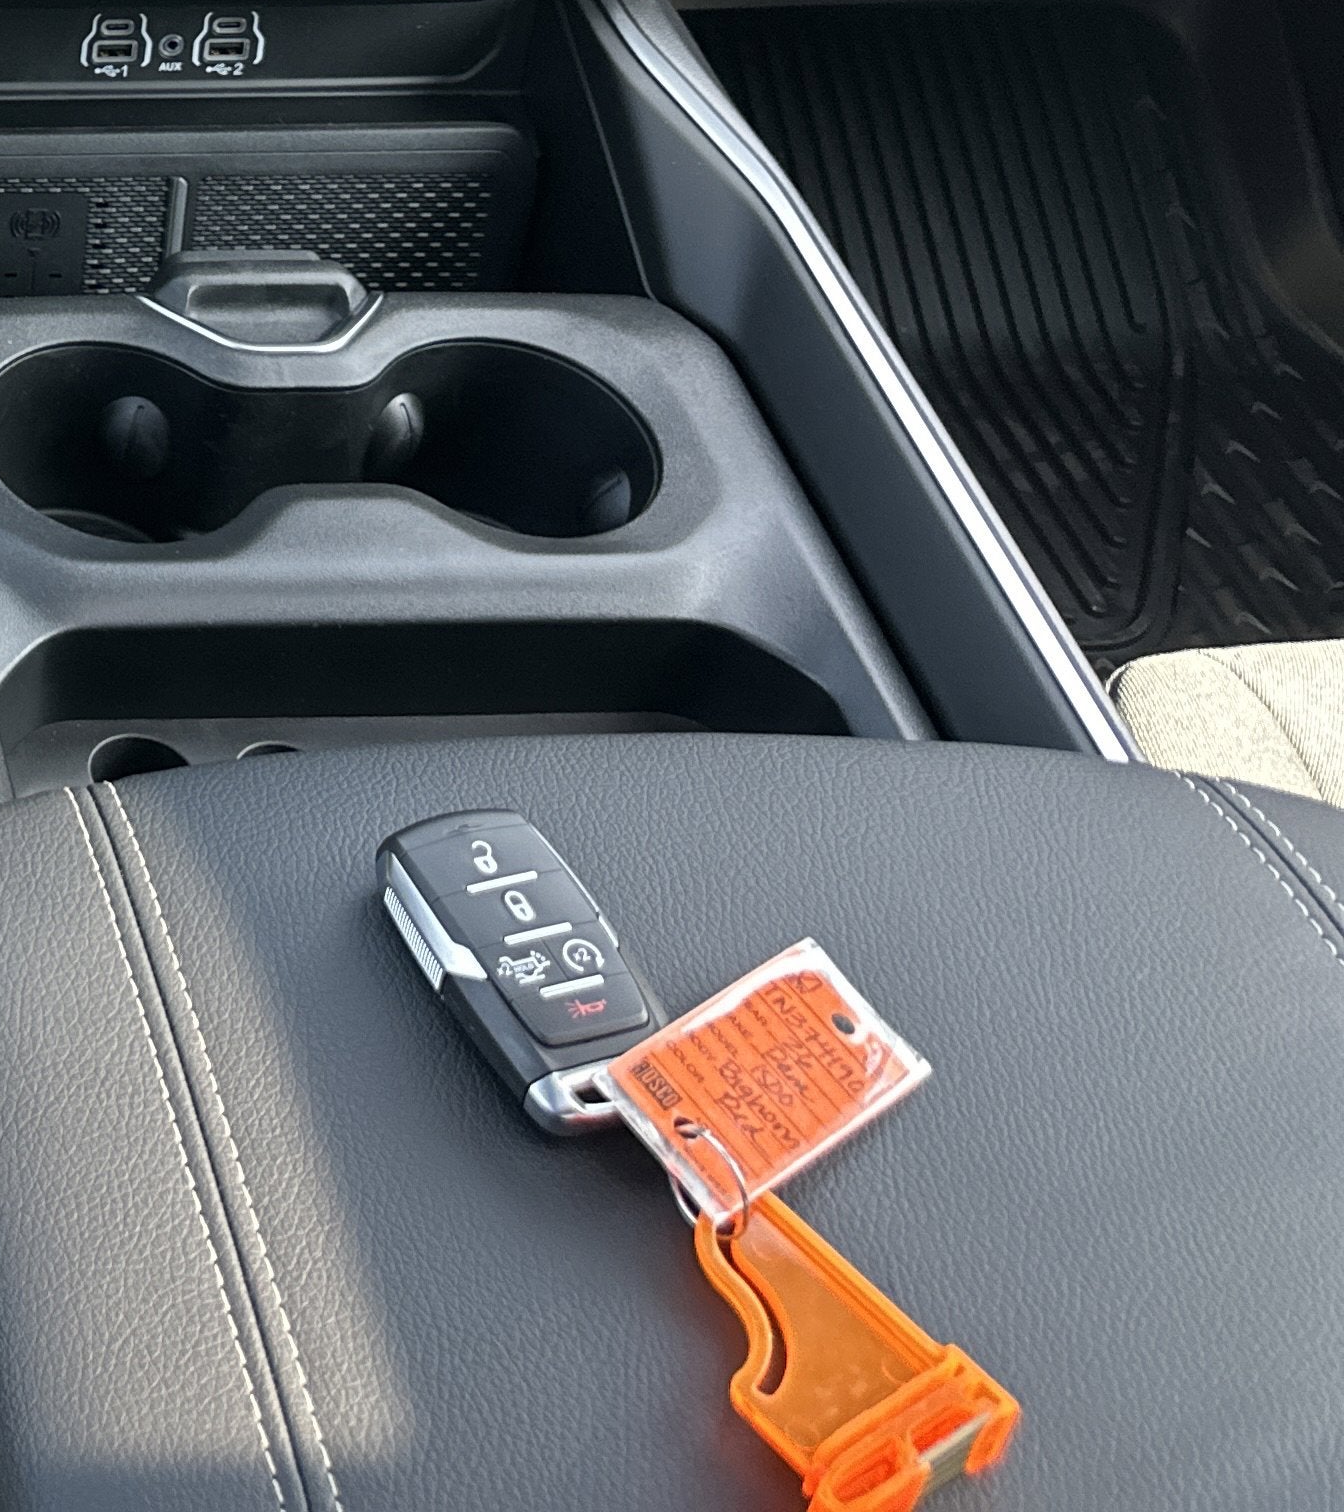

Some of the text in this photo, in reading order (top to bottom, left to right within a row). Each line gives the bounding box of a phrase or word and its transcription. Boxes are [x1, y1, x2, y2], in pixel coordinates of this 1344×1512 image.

[120, 65, 128, 77] 1
[158, 62, 182, 72] AUX
[233, 63, 244, 76] 2
